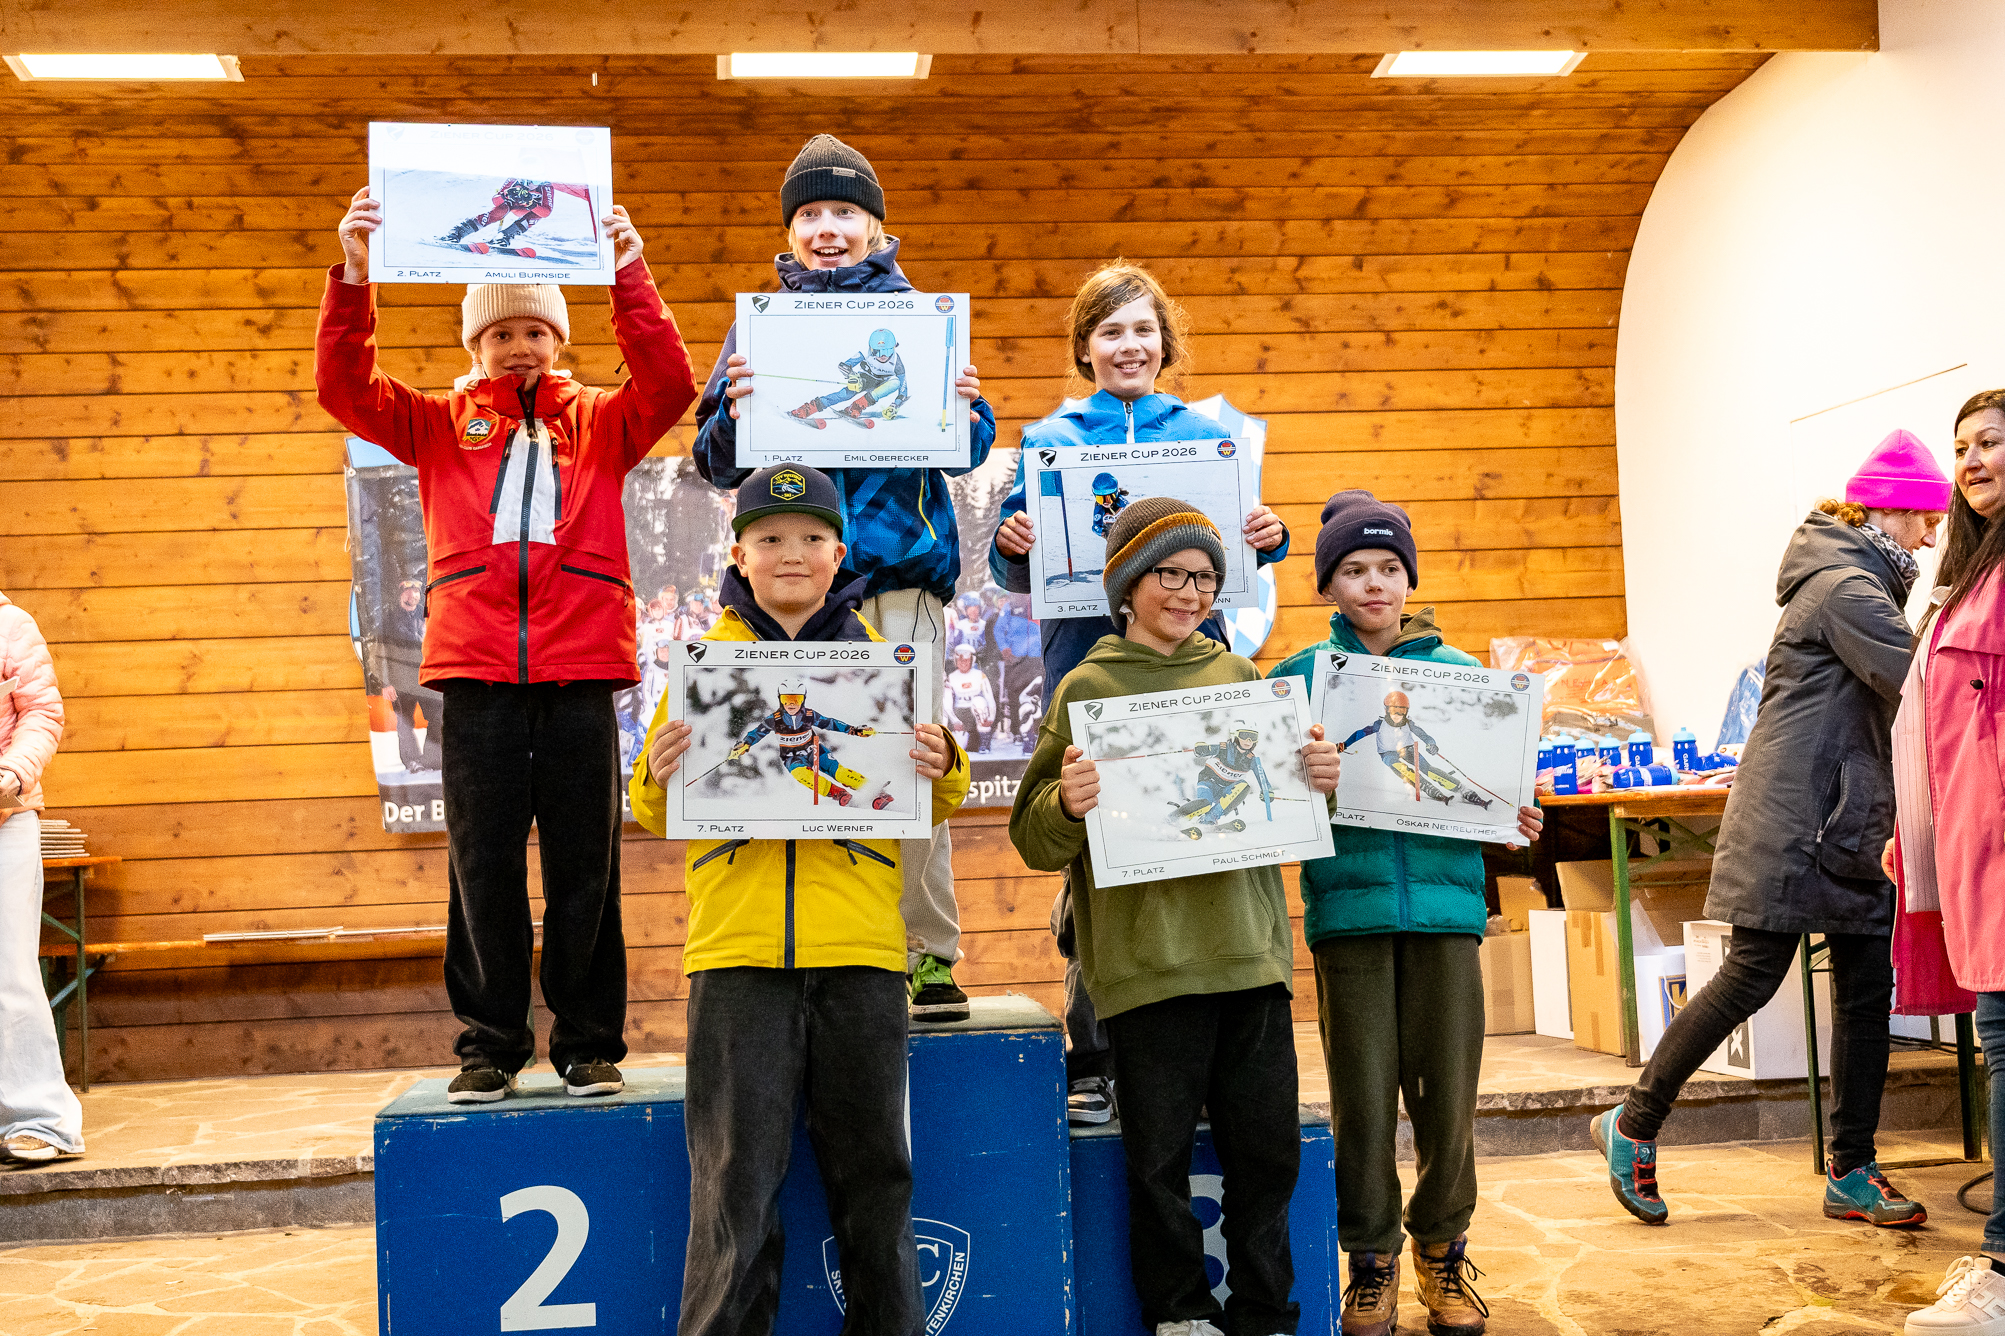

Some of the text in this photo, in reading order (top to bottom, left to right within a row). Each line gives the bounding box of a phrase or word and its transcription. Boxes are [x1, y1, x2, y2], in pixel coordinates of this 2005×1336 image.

[517, 132, 554, 141] 2026
[878, 301, 913, 309] 2026
[1162, 448, 1196, 457] 2026
[735, 650, 869, 659] ZIENER CUP 2026
[1454, 672, 1489, 683] 2026
[1215, 690, 1250, 701] 2026
[385, 801, 425, 823] Der
[963, 775, 1022, 805] spitz
[1122, 870, 1130, 878] 7.
[499, 1185, 597, 1332] 2
[926, 1251, 966, 1336] TENKIRCHEN
